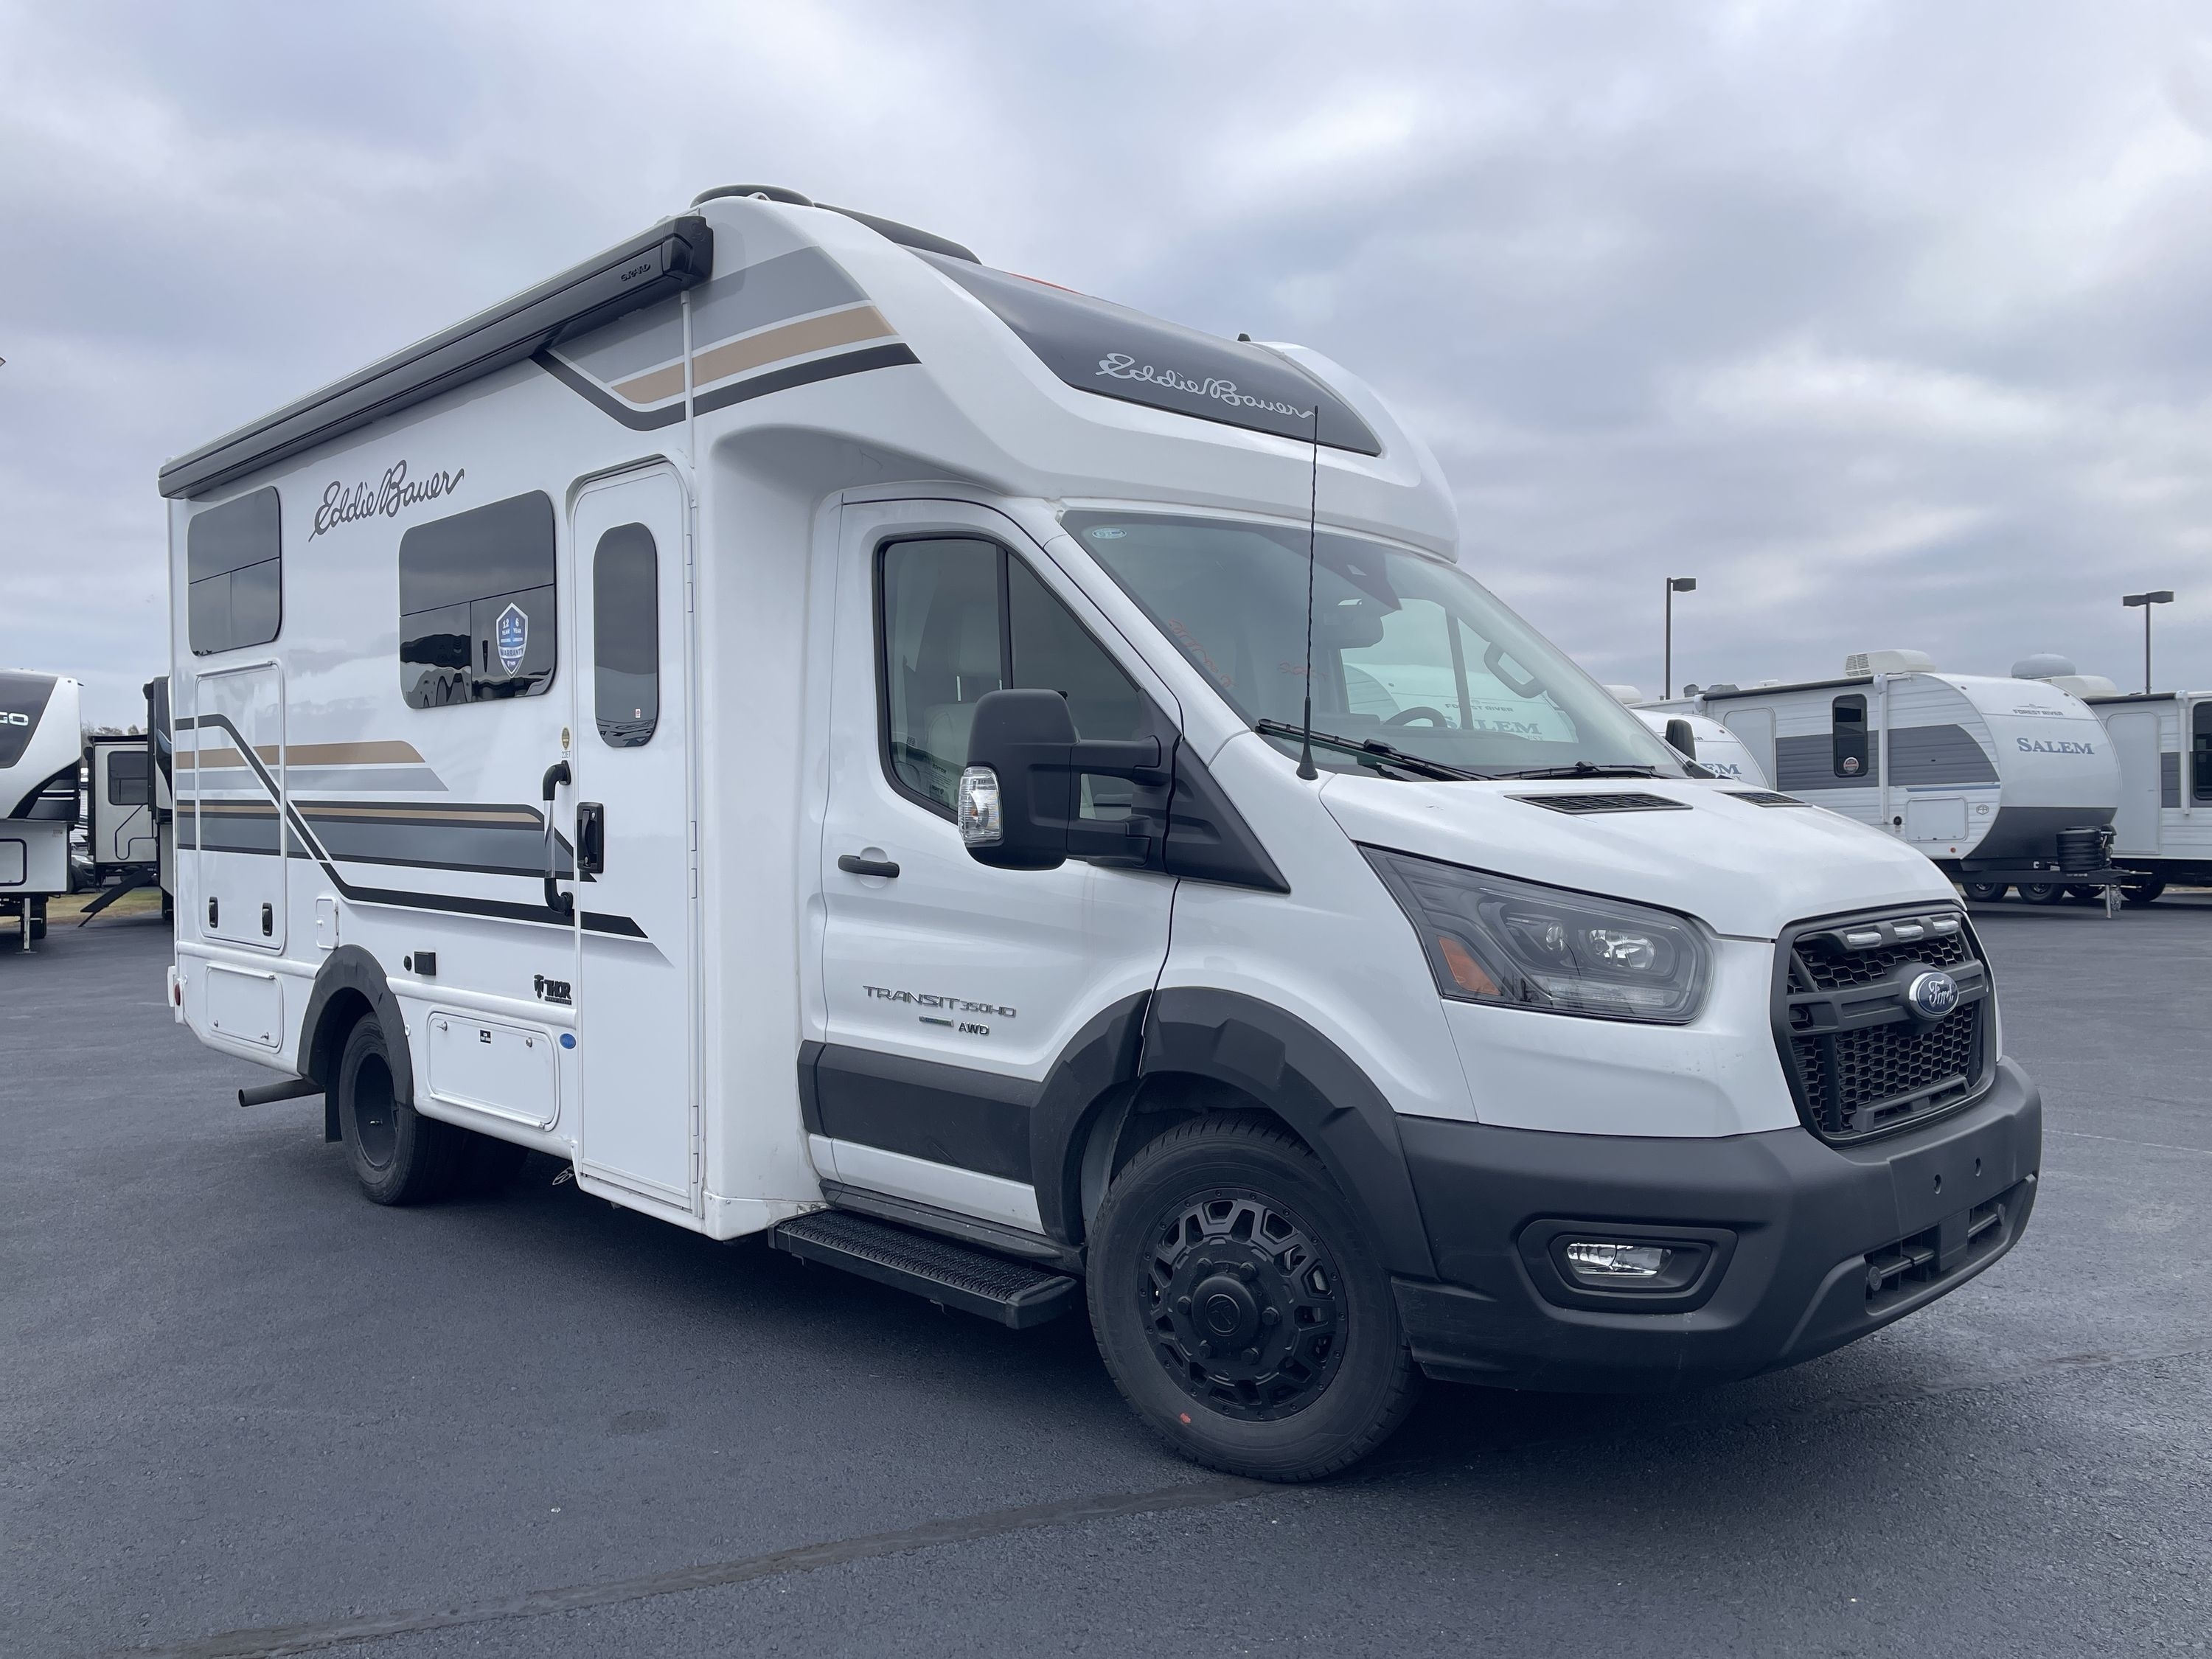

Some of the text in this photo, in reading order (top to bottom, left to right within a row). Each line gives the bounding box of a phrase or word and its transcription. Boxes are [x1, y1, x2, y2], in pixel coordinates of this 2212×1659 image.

[1096, 353, 1315, 419] Eddie Bauer
[308, 459, 465, 543] Eddie Bauer
[502, 618, 509, 629] 12
[515, 617, 520, 627] 6
[2017, 737, 2095, 754] SALEM
[544, 978, 571, 1000] THOR
[1927, 979, 1955, 1005] Ford
[863, 985, 1017, 1018] TRANSIT 350HD
[958, 1021, 990, 1036] AWD
